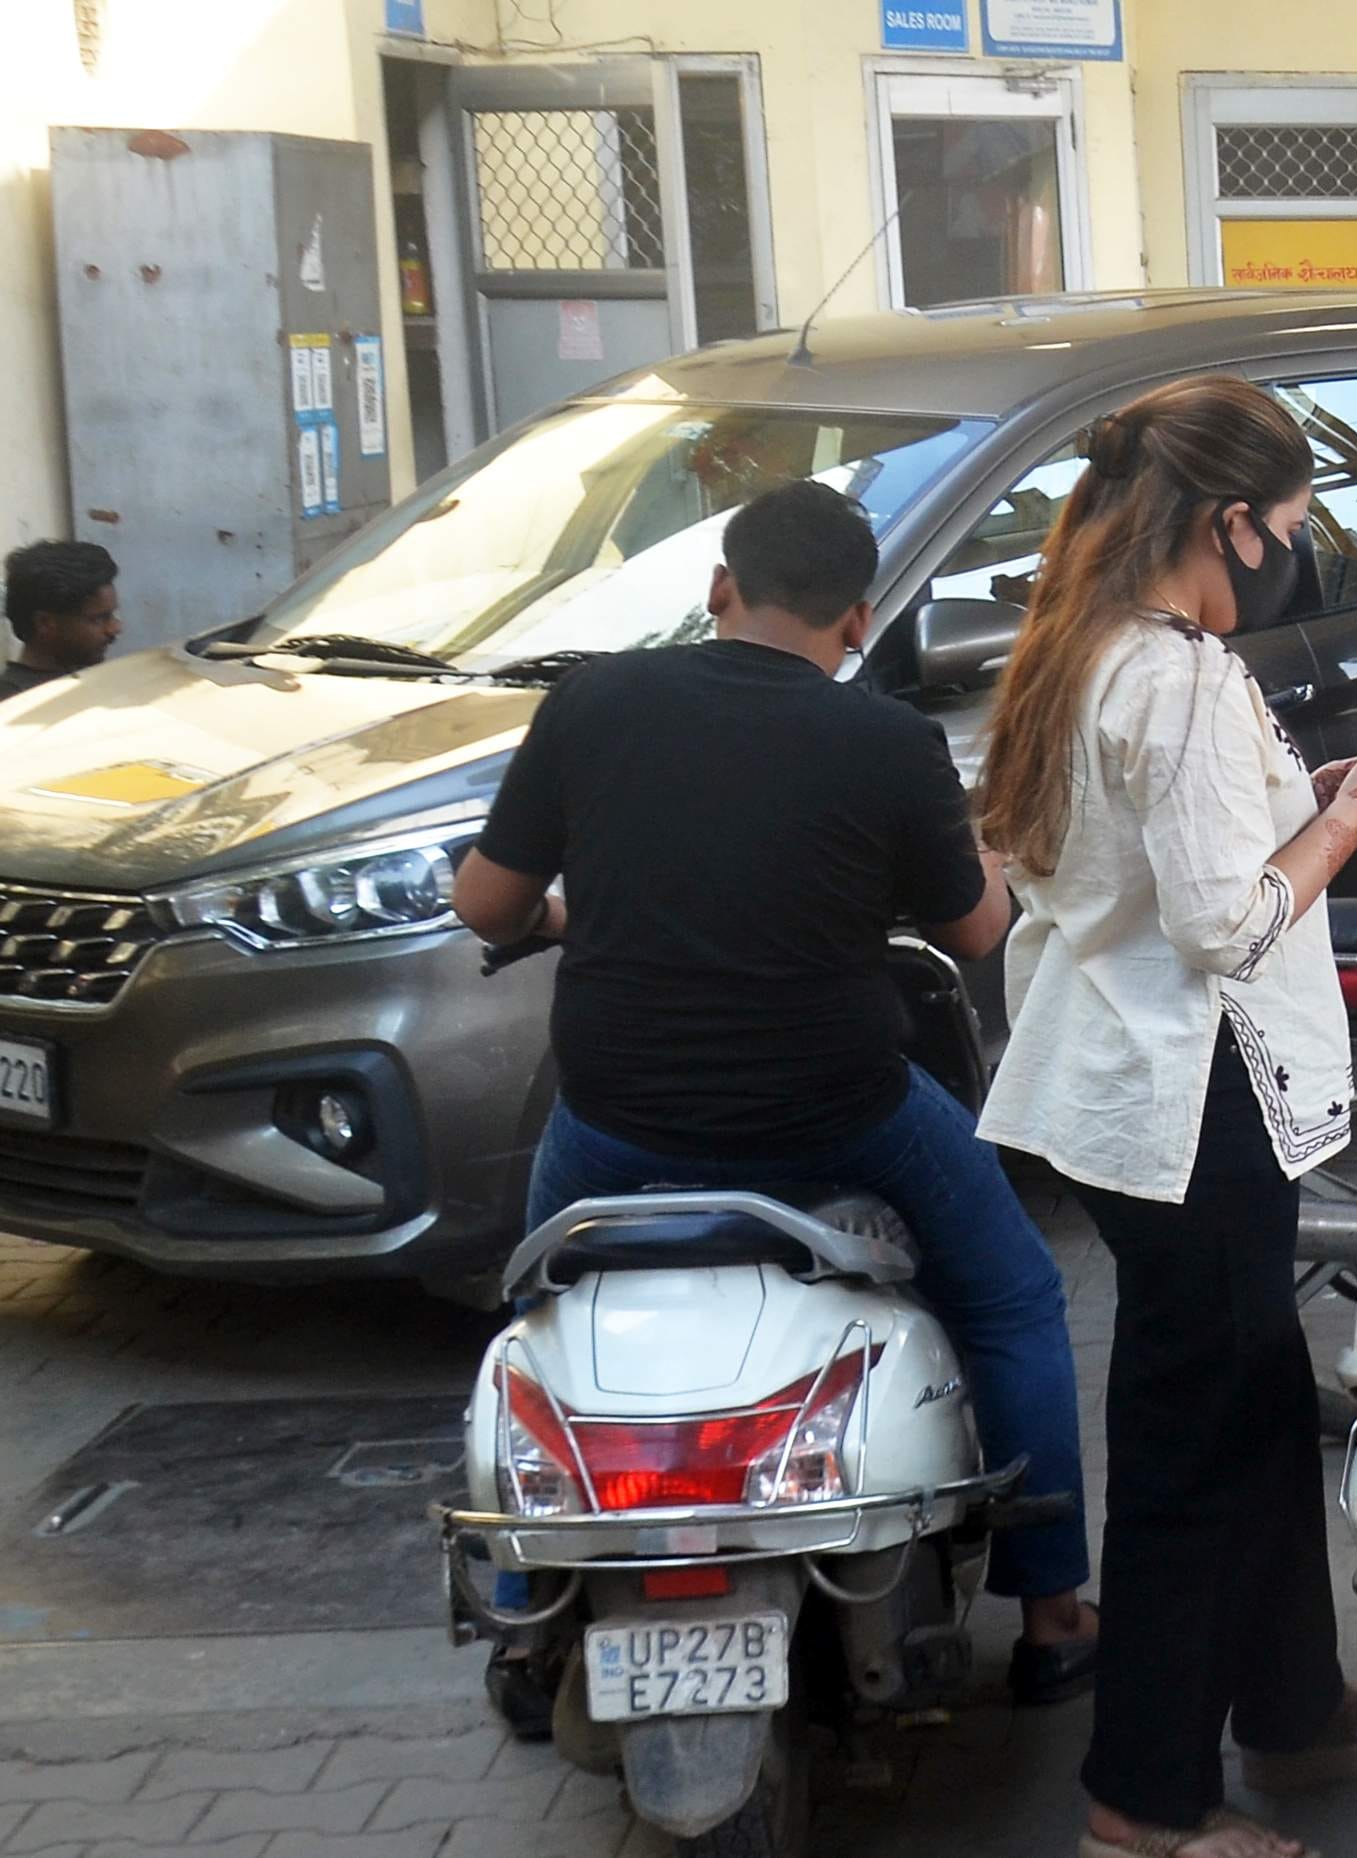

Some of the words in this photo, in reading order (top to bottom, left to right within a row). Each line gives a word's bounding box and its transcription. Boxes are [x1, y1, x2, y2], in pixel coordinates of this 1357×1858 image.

[886, 11, 925, 30] SALES
[927, 13, 962, 31] ROOM
[0, 1056, 47, 1104] 220
[630, 1622, 765, 1667] UP27B
[630, 1666, 766, 1712] E7273
